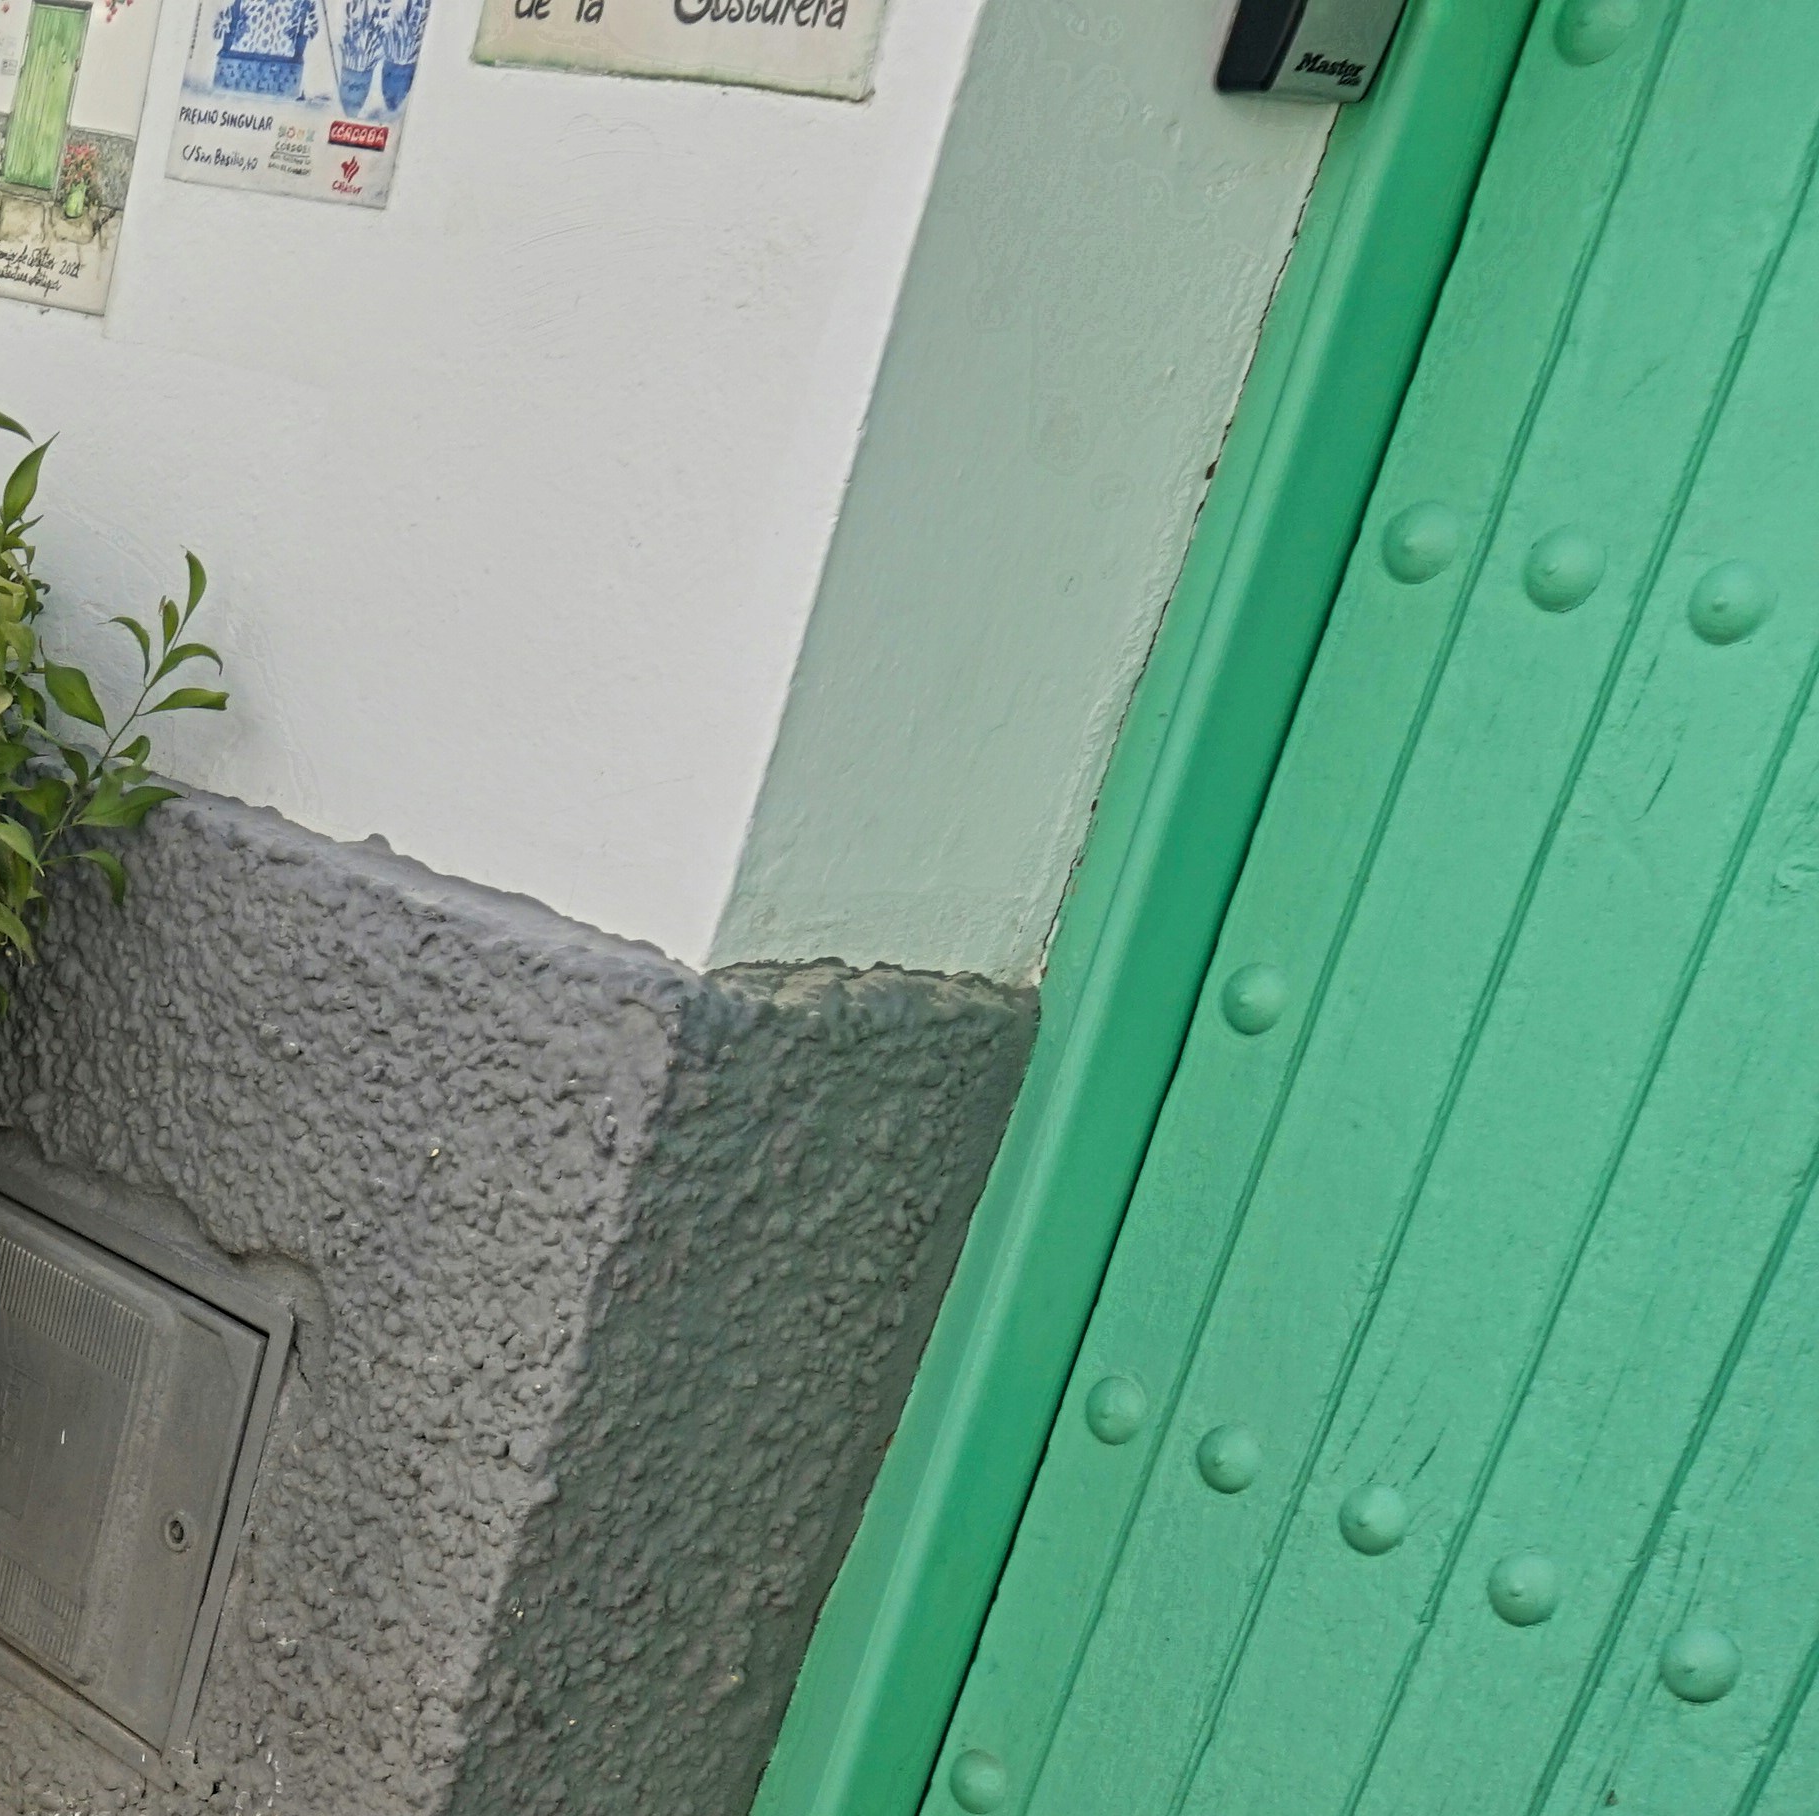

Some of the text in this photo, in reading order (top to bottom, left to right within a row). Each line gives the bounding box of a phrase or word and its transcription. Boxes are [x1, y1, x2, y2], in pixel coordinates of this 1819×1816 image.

[1294, 52, 1367, 77] Master
[179, 106, 274, 132] PREMIO SINGULAR
